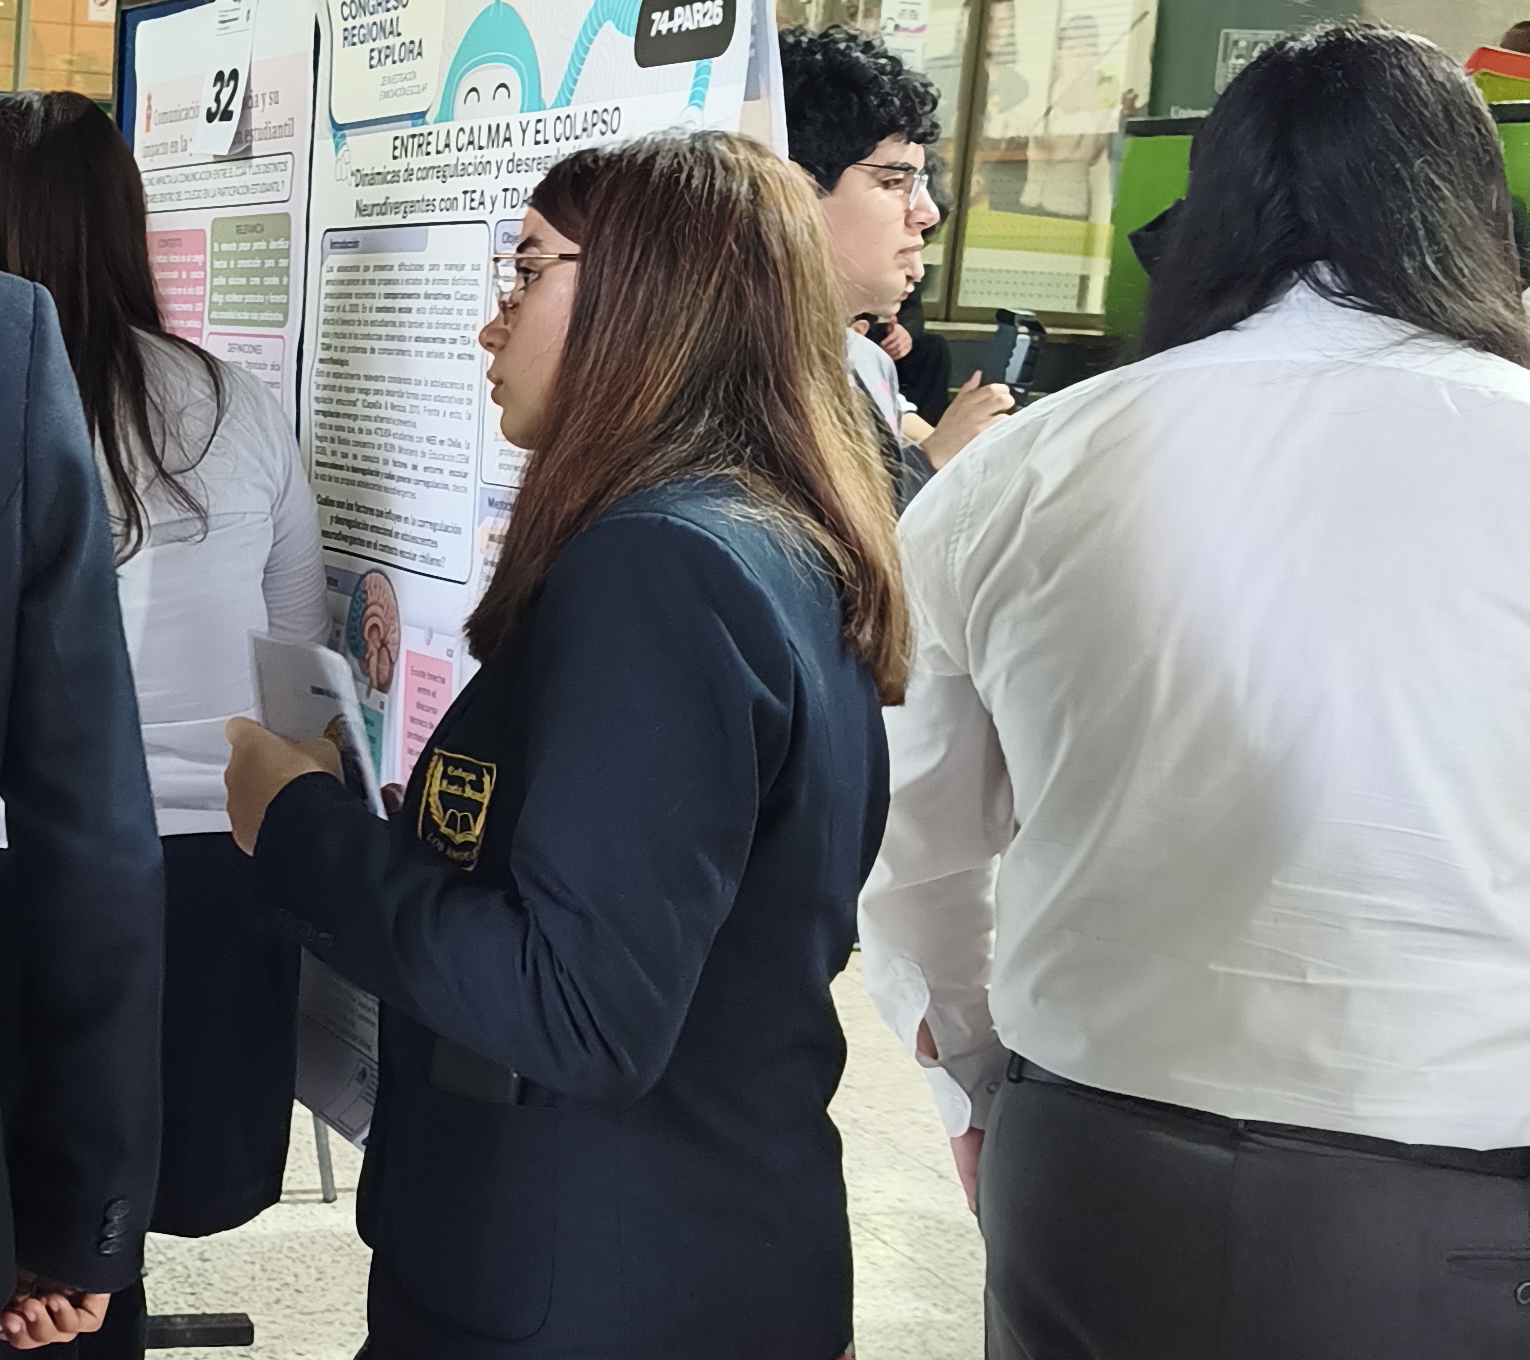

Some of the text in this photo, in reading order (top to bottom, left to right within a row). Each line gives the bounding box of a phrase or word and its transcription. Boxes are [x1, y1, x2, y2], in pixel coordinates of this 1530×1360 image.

[342, 16, 402, 48] REGIONAL
[369, 37, 423, 69] EXPLORA
[205, 67, 240, 124] 32
[244, 117, 295, 144] estudiantil
[392, 106, 622, 160] ENTRE LA CALMA Y EL COLAPSO
[402, 162, 414, 181] de
[415, 155, 492, 183] corregulación
[495, 158, 504, 179] y
[354, 186, 531, 220] Neurodivergentes con TEA y TDA
